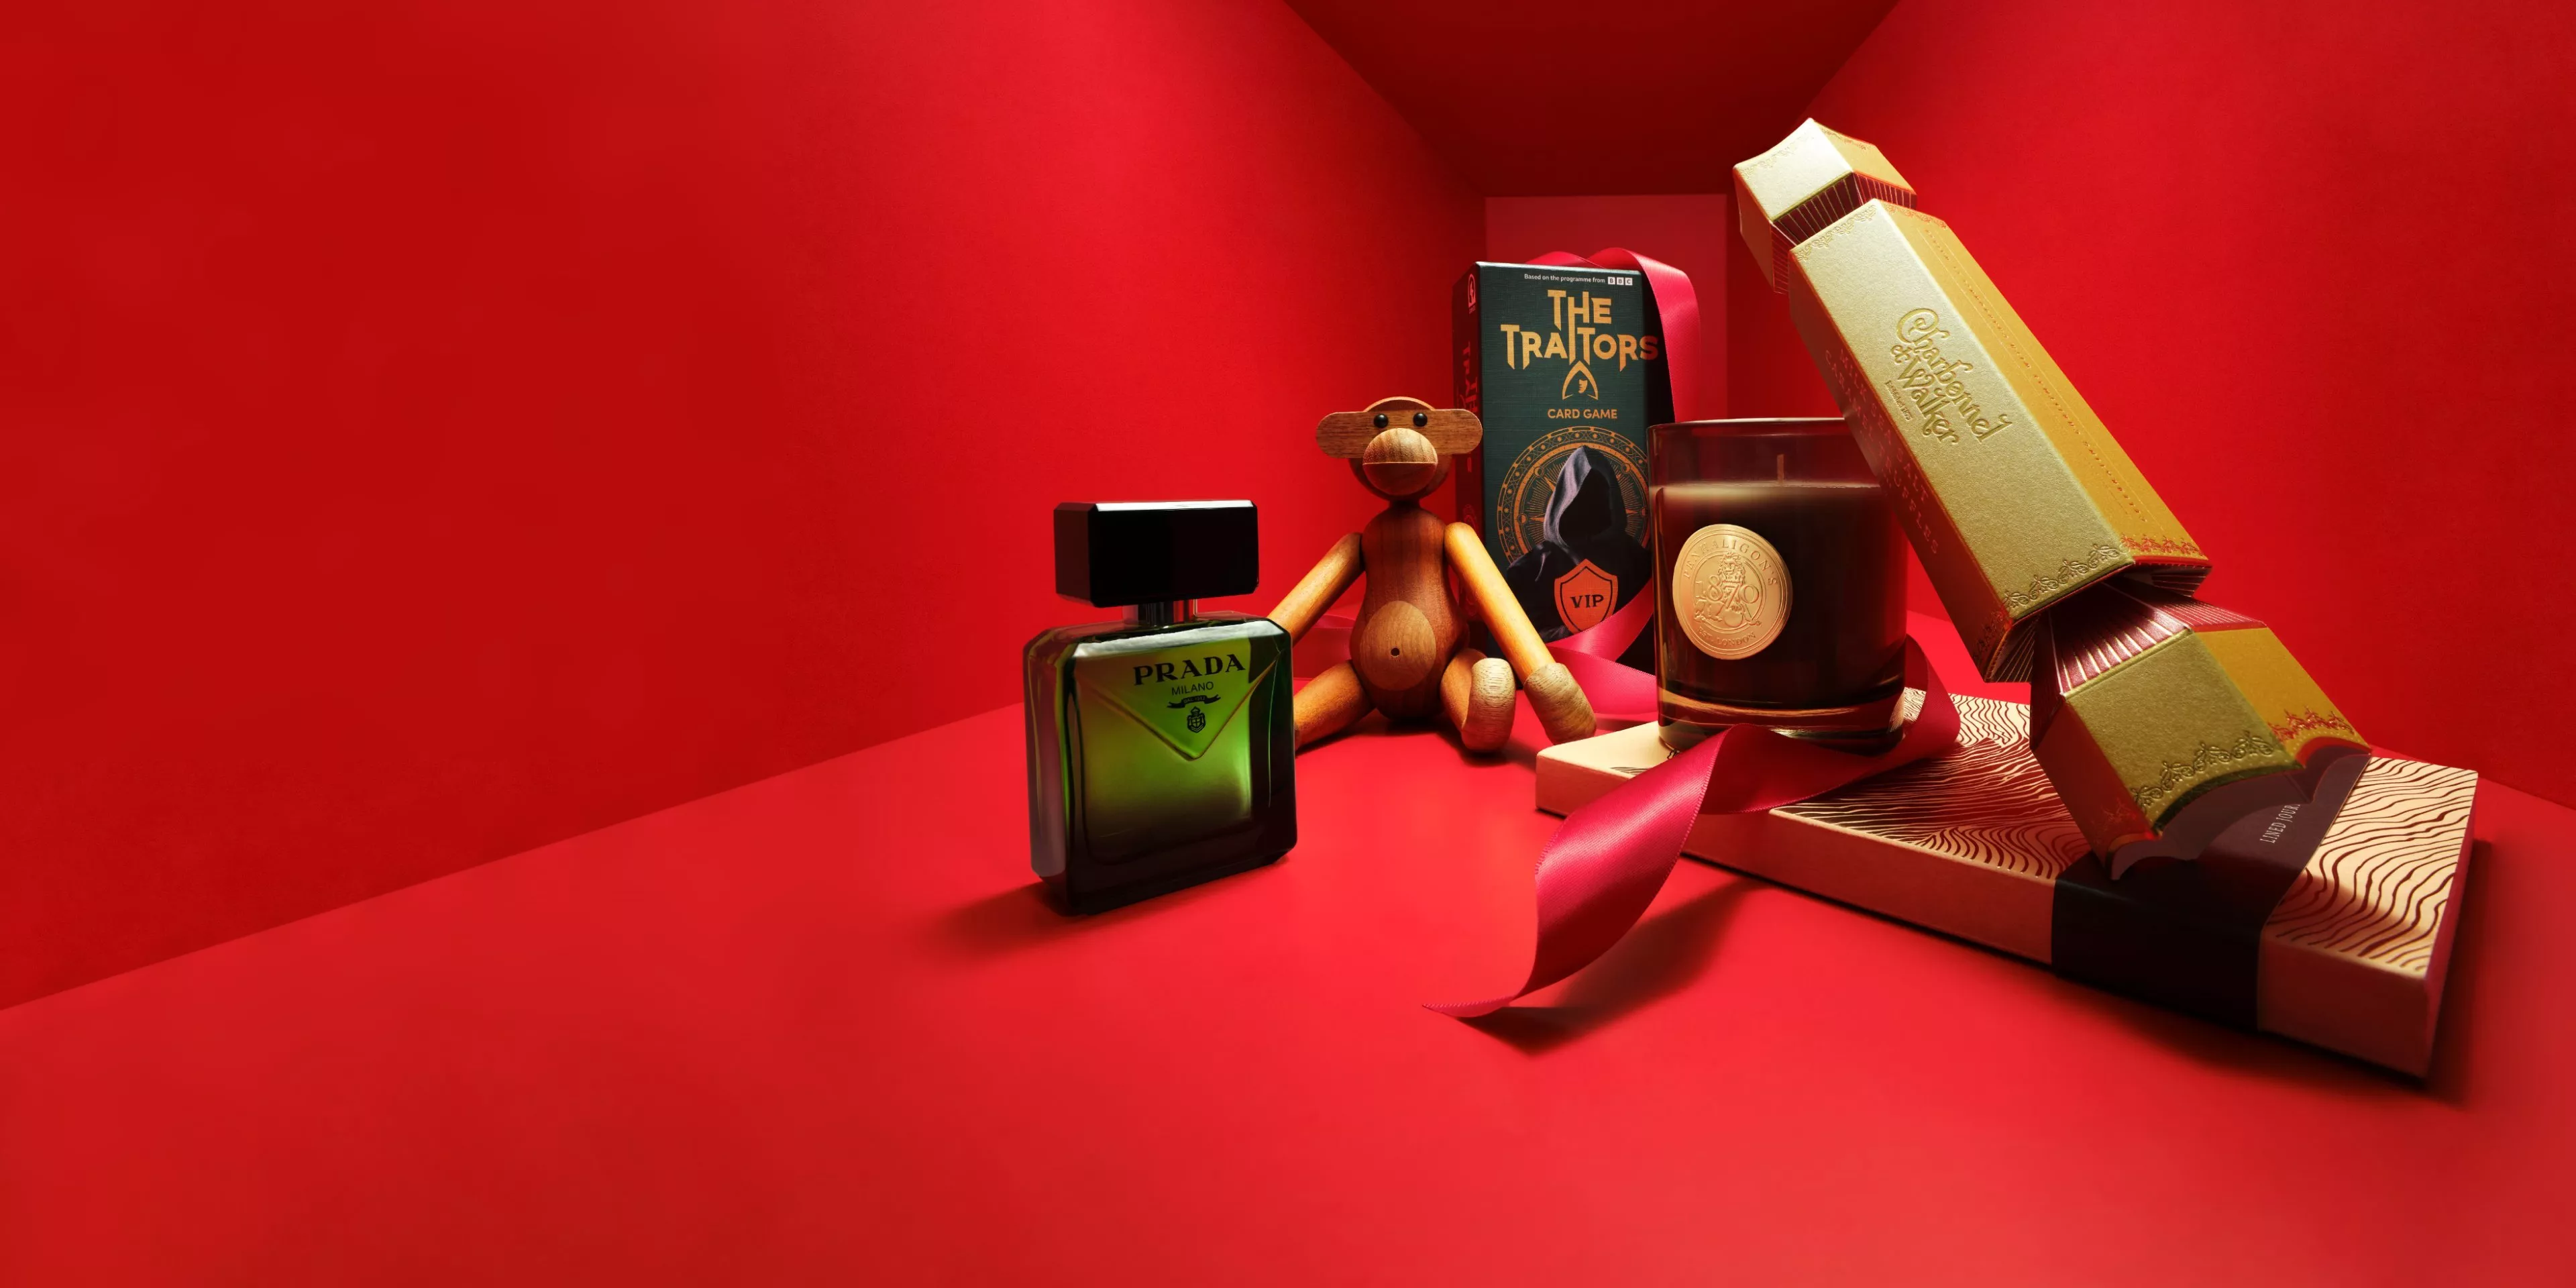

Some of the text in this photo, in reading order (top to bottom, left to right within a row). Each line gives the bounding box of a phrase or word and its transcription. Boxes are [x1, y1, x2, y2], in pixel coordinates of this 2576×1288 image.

[1547, 289, 1612, 331] THE
[1500, 324, 1659, 372] TRAITORS
[1896, 308, 2012, 443] Charbonnel
[1547, 409, 1618, 419] CARD GAME
[1897, 358, 1960, 445] Walker
[1570, 594, 1605, 609] VIP
[1695, 574, 1760, 610] 1870
[1133, 653, 1246, 686] PRADA
[1171, 680, 1214, 696] MILANO
[2259, 804, 2301, 843] LINED JOUR
